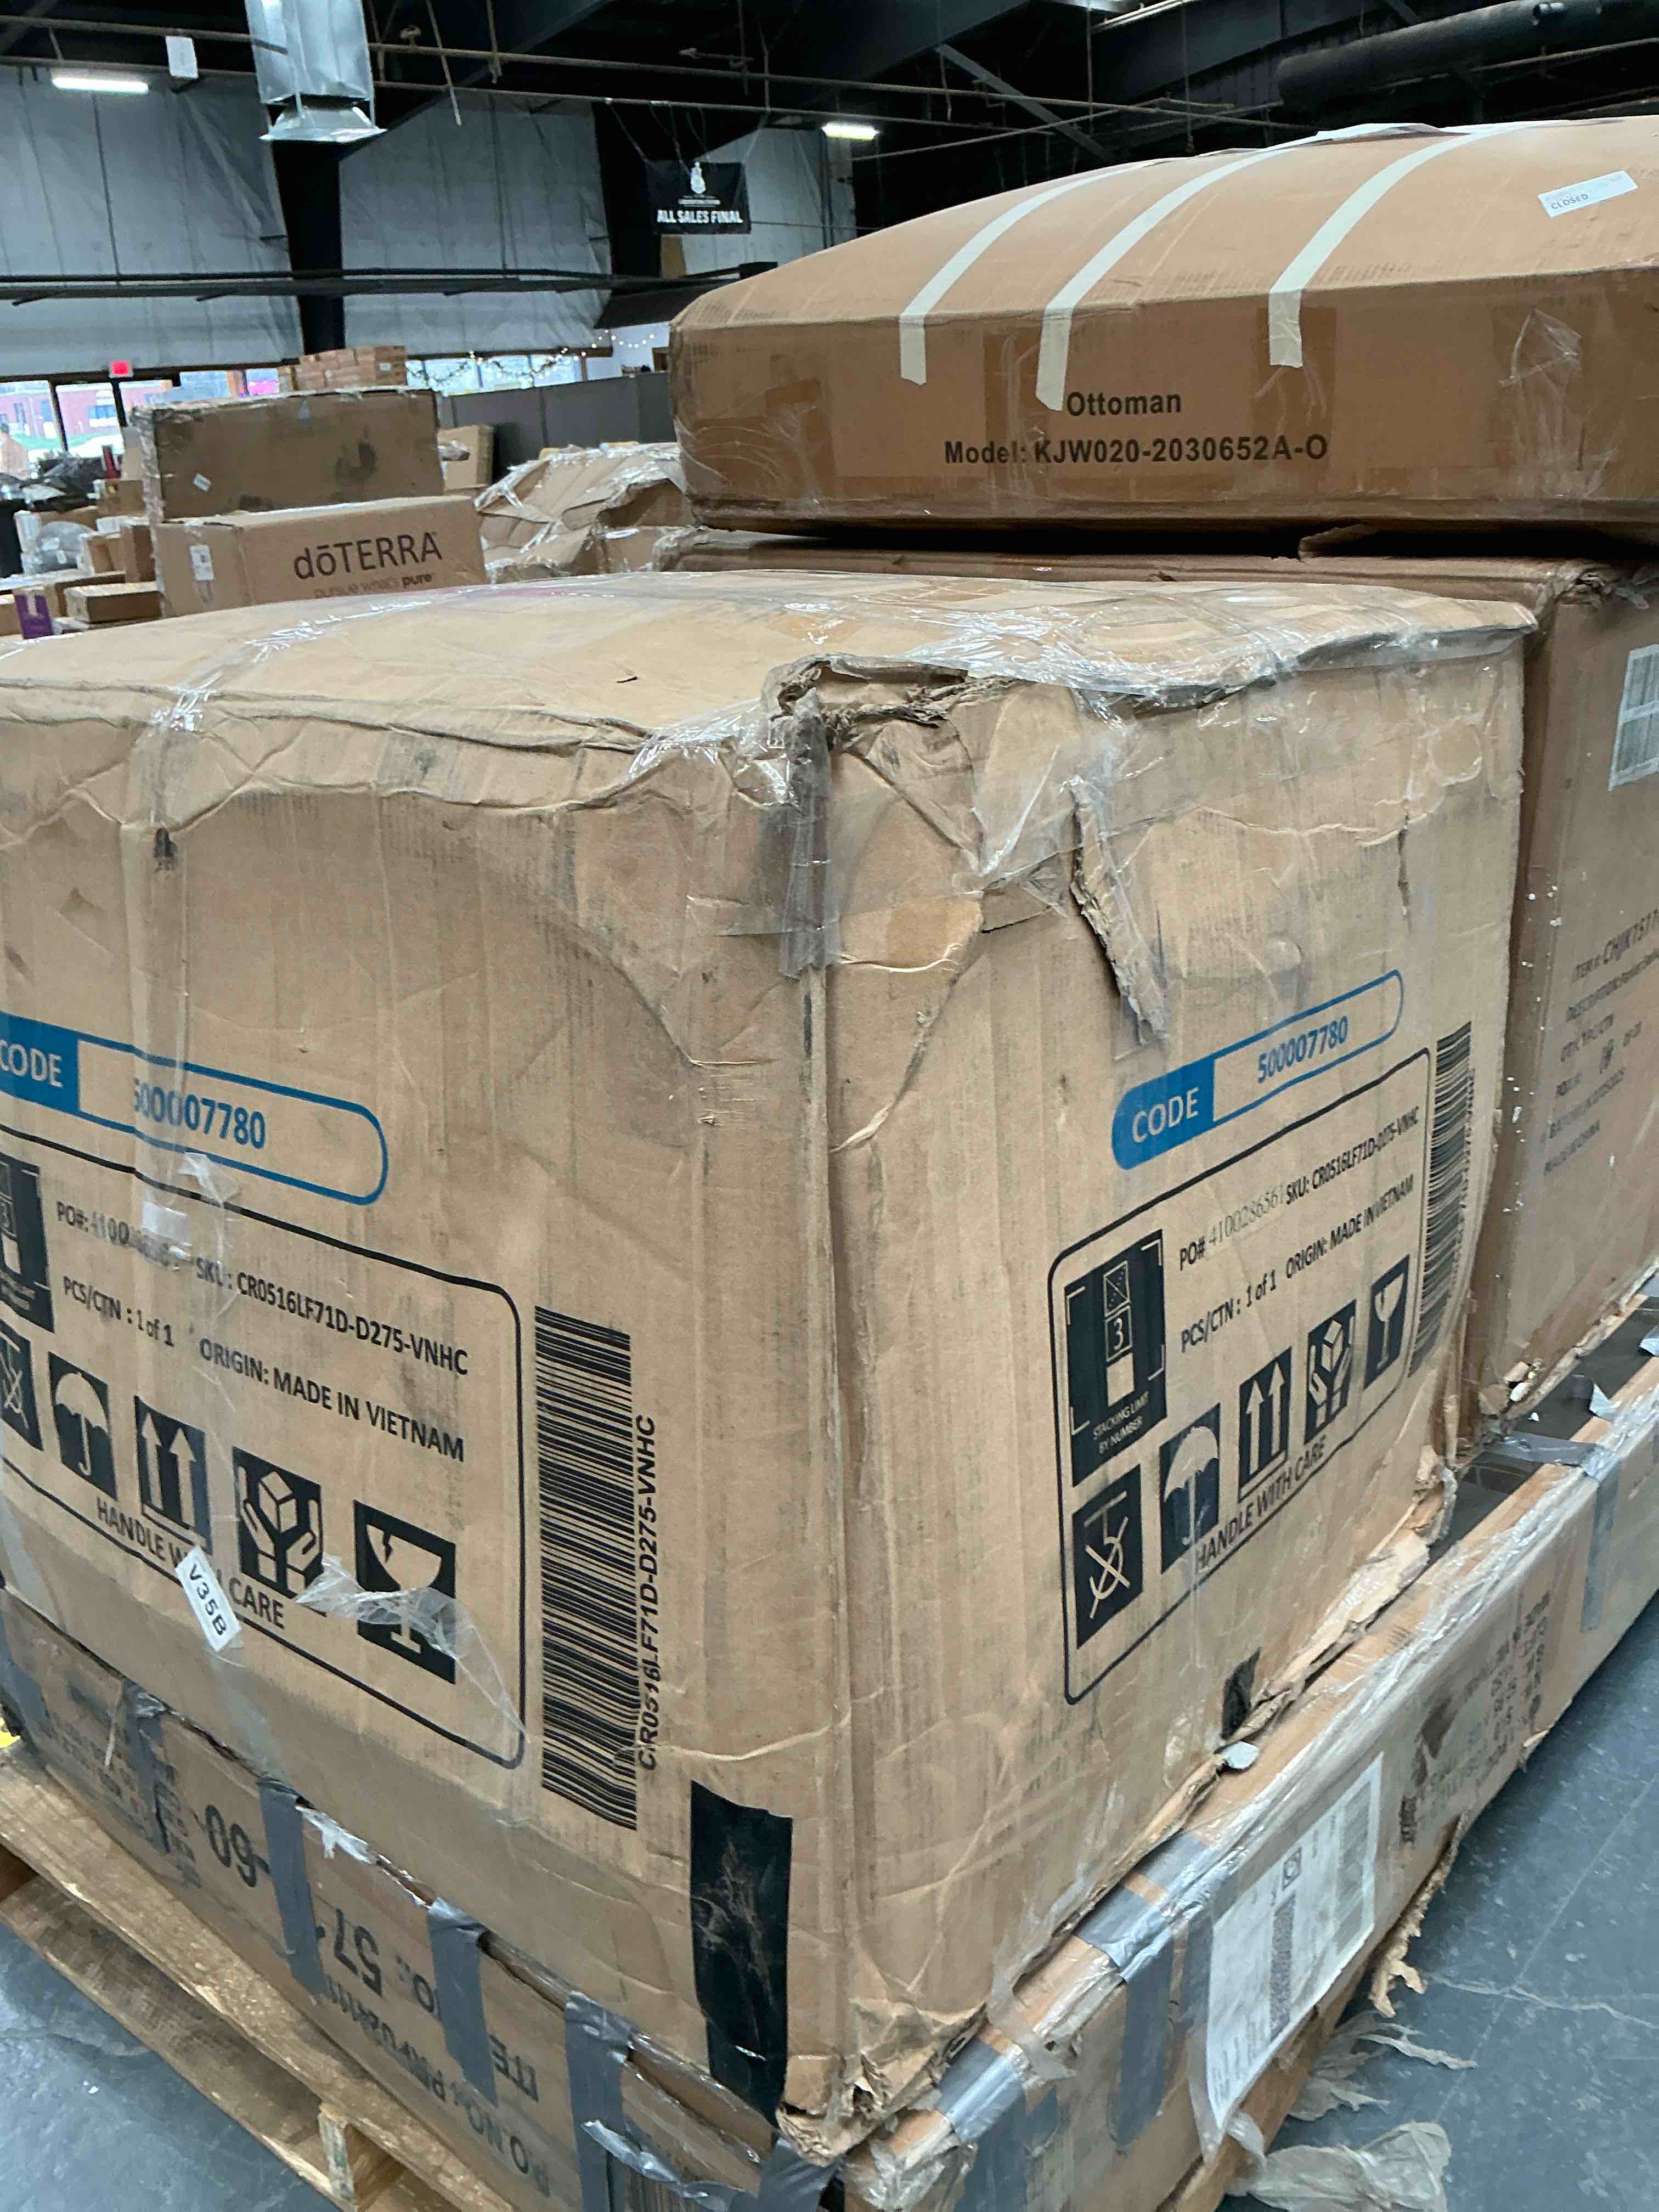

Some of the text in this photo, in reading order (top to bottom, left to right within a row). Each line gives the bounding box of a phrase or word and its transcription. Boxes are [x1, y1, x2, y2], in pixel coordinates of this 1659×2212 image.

[657, 210, 743, 223] ALL SALES FINAL
[1551, 193, 1589, 210] CLOSED
[1066, 392, 1182, 416] Ottoman
[944, 441, 1028, 464] Model:
[1132, 1015, 1349, 1143] CODE 500007780
[1286, 1175, 1309, 1205] SKU:
[1255, 1270, 1269, 1300] of
[1286, 1236, 1328, 1279] ORIGIN:
[1330, 1213, 1362, 1250] MADE
[1364, 1205, 1374, 1227] IN
[1373, 1172, 1414, 1221] VIETNAM
[238, 1272, 468, 1375] CR0516LF71D-D275-VNHC
[1113, 1317, 1124, 1351] 3
[146, 1318, 160, 1341] of
[164, 1324, 175, 1347] 1
[200, 1338, 269, 1385] ORIGIN:
[274, 1367, 332, 1410] MADE
[337, 1391, 360, 1420] IN
[366, 1401, 464, 1463] VIETNAM
[97, 1497, 166, 1562] HANDLE
[1194, 1434, 1326, 1575] HANDLE WITH CARE
[189, 1564, 227, 1636] V35B
[229, 1577, 285, 1629] CARE
[635, 1414, 660, 1771] CR0516LF71D-D275-VNHC
